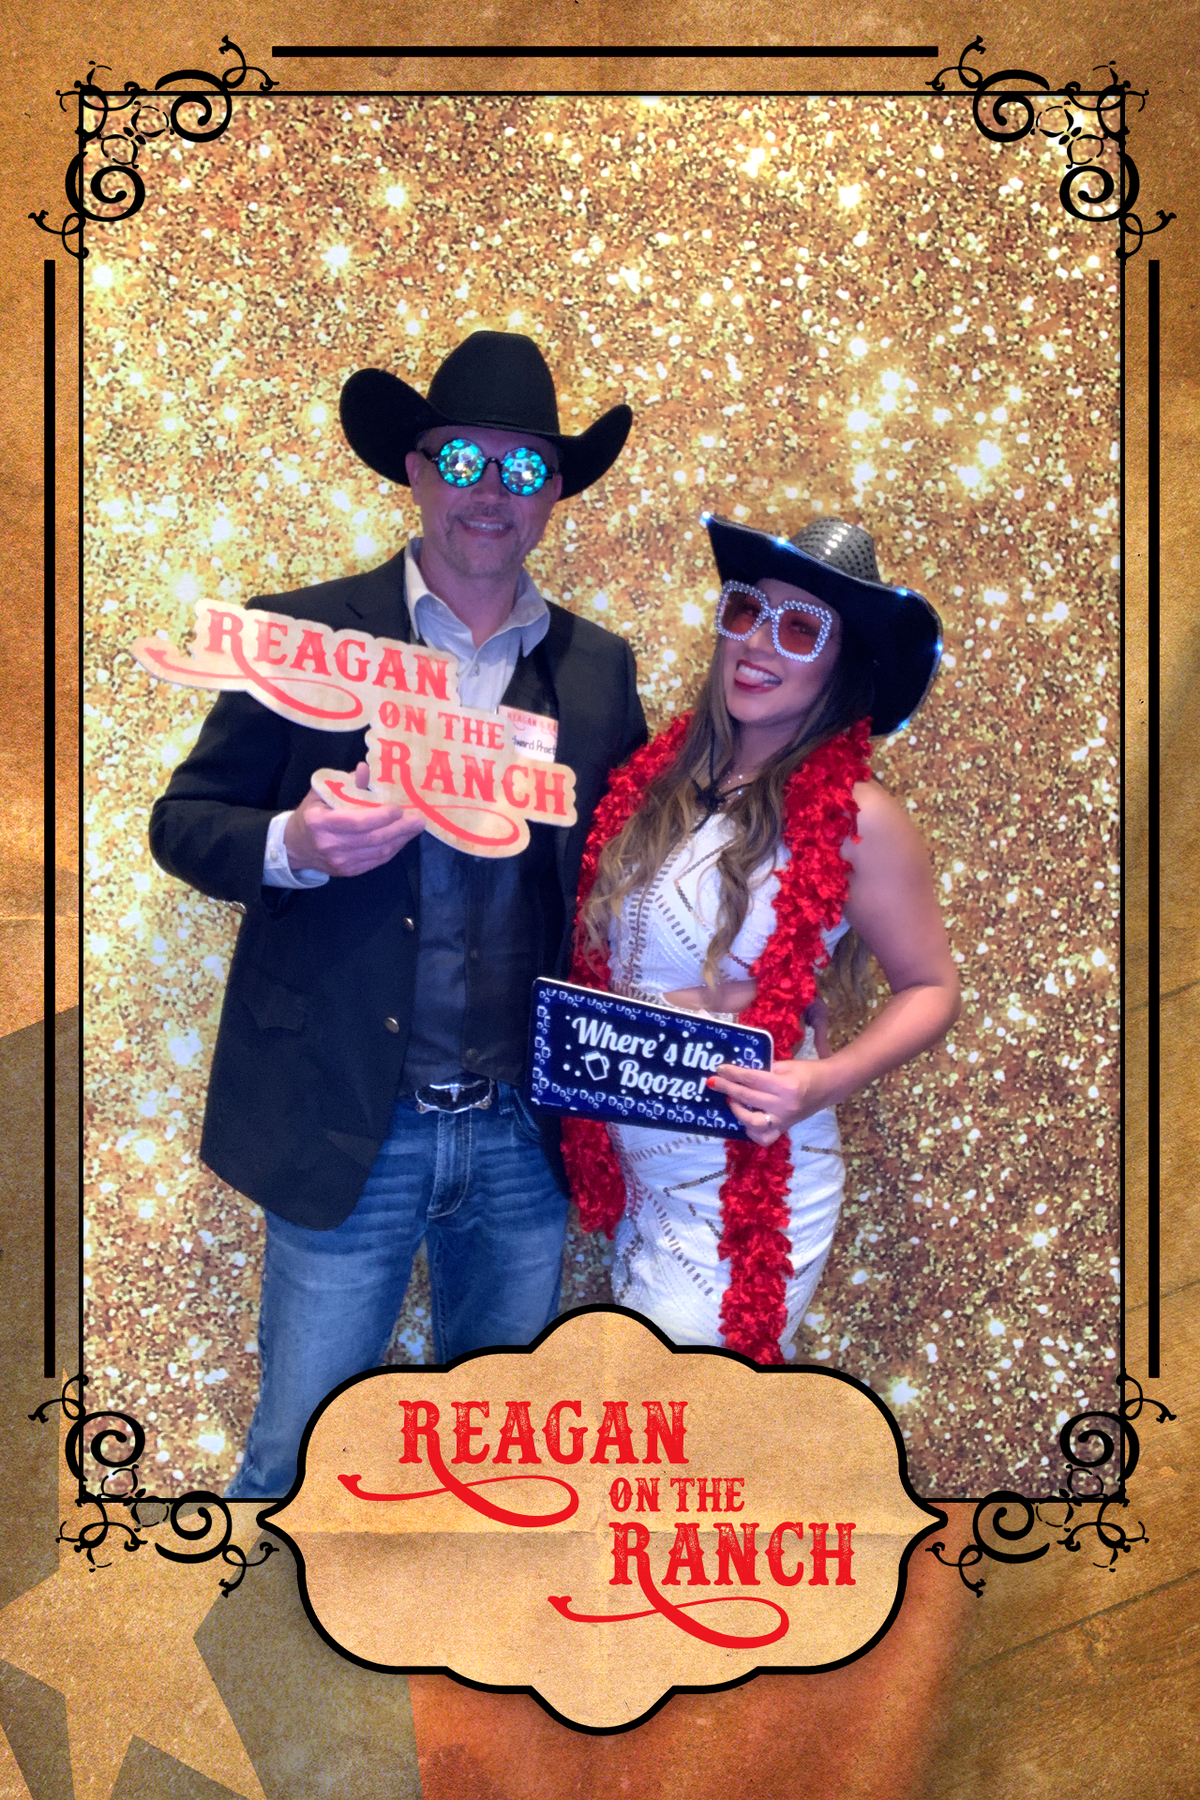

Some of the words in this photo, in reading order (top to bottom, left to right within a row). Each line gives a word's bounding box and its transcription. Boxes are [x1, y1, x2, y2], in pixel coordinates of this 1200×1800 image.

[204, 608, 451, 701] REAGAN
[379, 701, 427, 736] ON
[438, 713, 505, 751] THE
[377, 737, 568, 816] RANCH
[571, 1016, 678, 1067] Where's
[682, 1042, 725, 1072] the
[618, 1059, 708, 1102] Booze!
